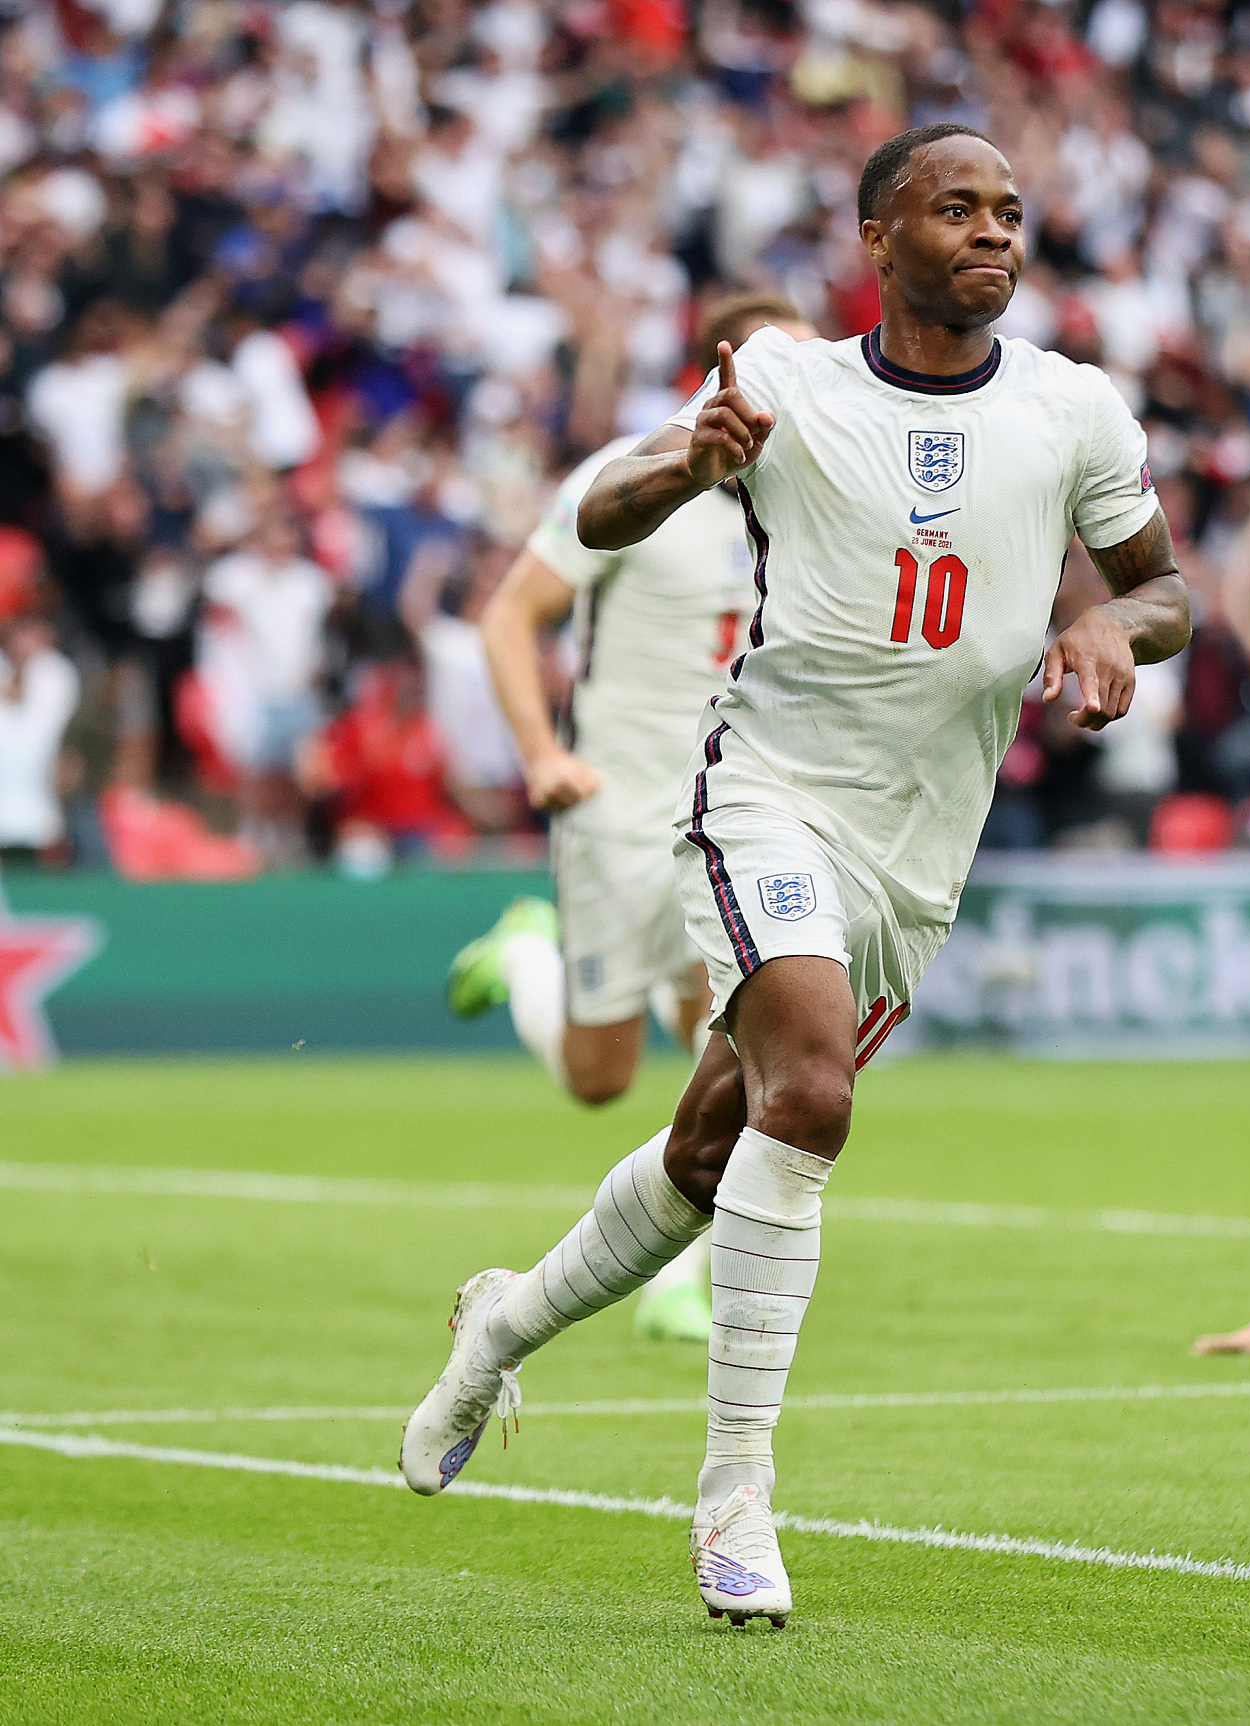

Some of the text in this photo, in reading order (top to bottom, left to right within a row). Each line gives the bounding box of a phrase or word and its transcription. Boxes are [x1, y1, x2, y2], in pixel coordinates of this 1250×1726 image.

[916, 528, 949, 539] GERMANY
[920, 538, 937, 547] JUNE
[938, 540, 952, 549] 2021
[891, 548, 968, 649] 10
